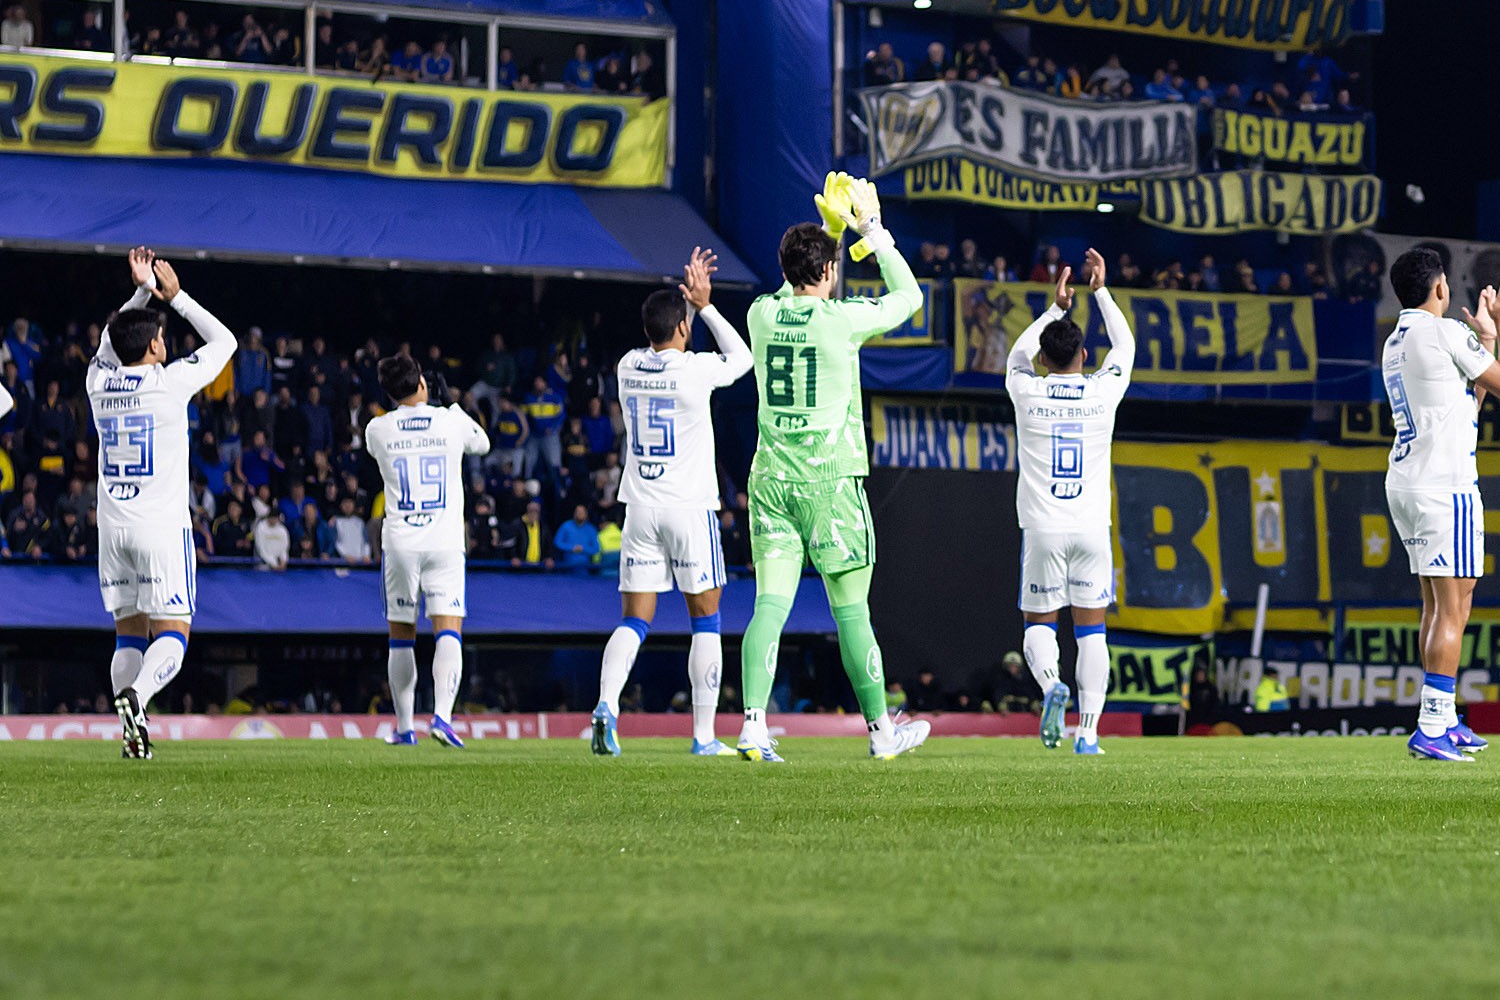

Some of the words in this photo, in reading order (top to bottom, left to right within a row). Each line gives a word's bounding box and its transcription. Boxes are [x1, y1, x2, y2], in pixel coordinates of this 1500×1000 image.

[153, 78, 628, 177] QUERIDO
[950, 83, 1005, 151] ES
[1020, 109, 1195, 174] FAMILIA
[1146, 172, 1376, 229] OBLIGADO
[765, 344, 816, 408] 81
[1048, 385, 1083, 399] Vilma
[98, 413, 154, 477] 23
[626, 395, 676, 457] 15
[1051, 422, 1084, 479] 6
[393, 455, 447, 510] 19
[1054, 482, 1081, 497] BH
